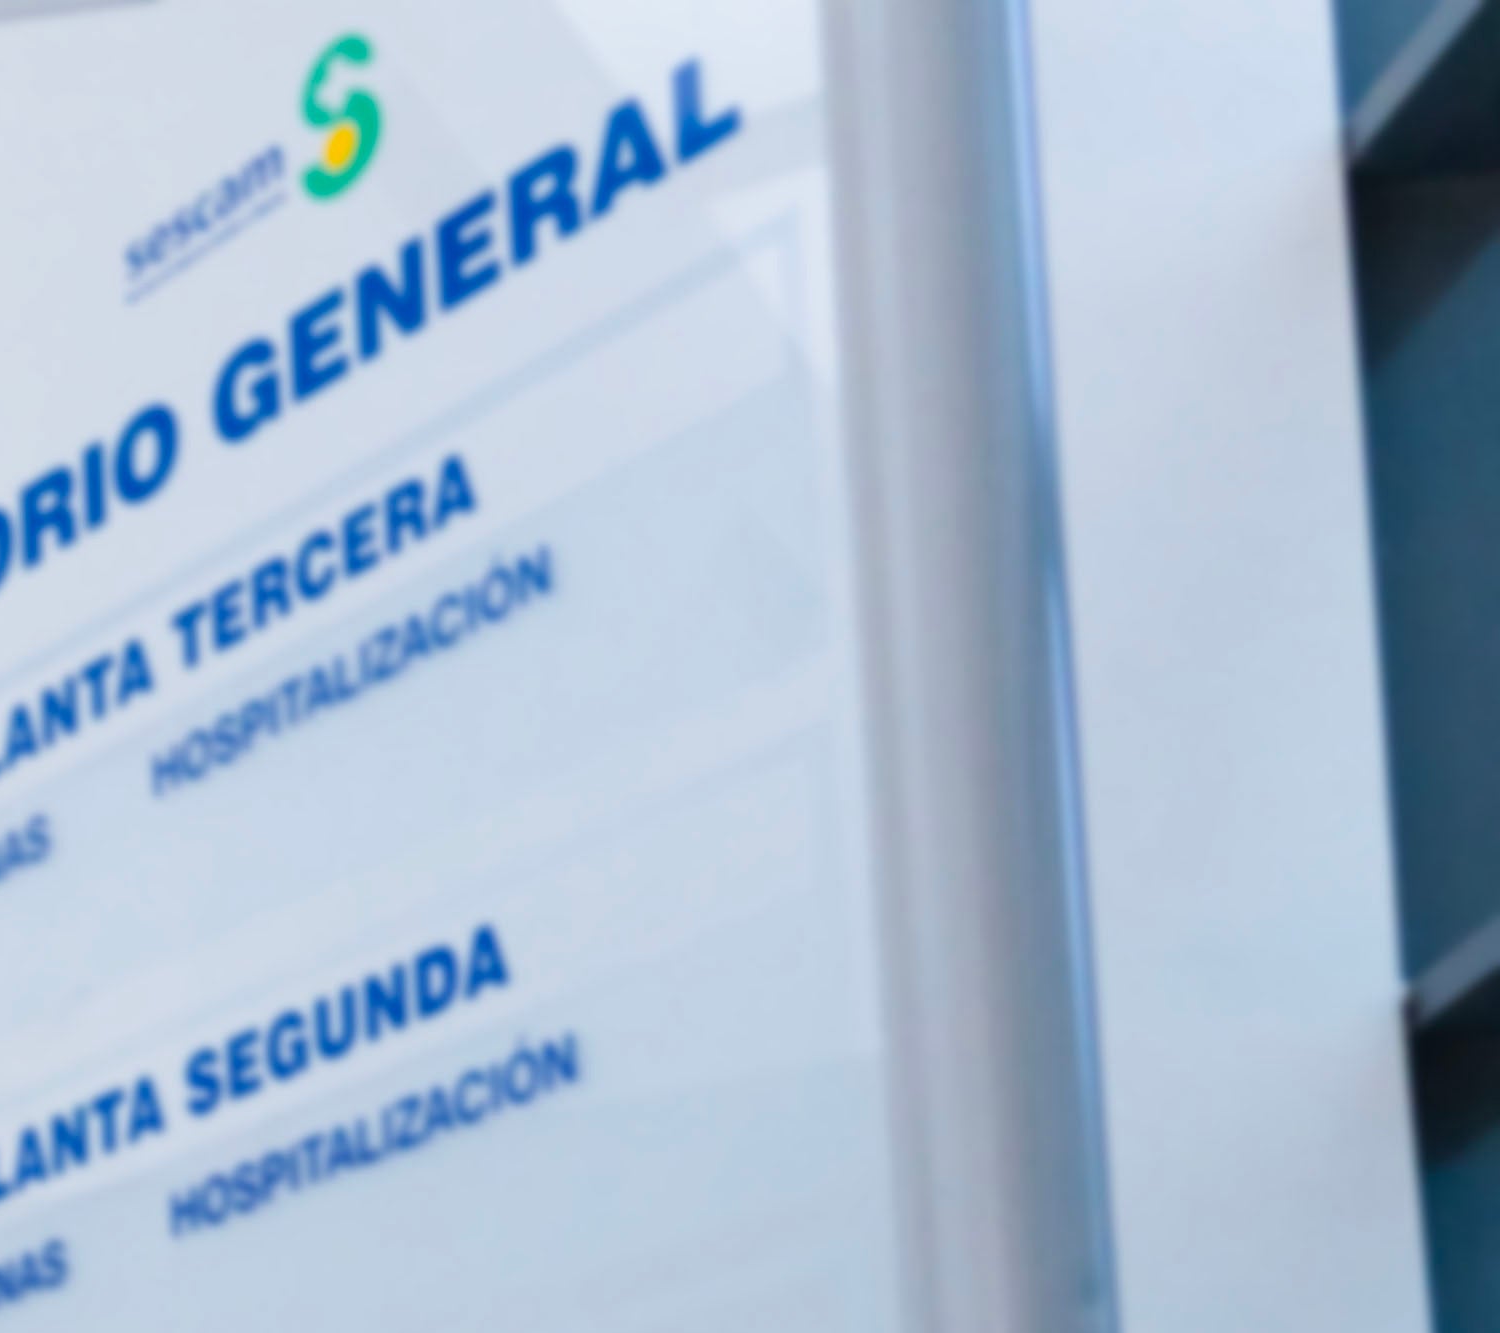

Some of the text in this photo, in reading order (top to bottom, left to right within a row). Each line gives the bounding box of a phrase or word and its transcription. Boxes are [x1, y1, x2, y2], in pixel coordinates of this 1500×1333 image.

[123, 143, 285, 278] sescam
[210, 55, 742, 446] GENERAL
[149, 541, 556, 798] HOSPITALIZACIÓN
[169, 452, 480, 673] TERCERA
[183, 923, 512, 1119] SEGUNDA
[168, 1031, 582, 1240] HOSPITALIZACIÓN
